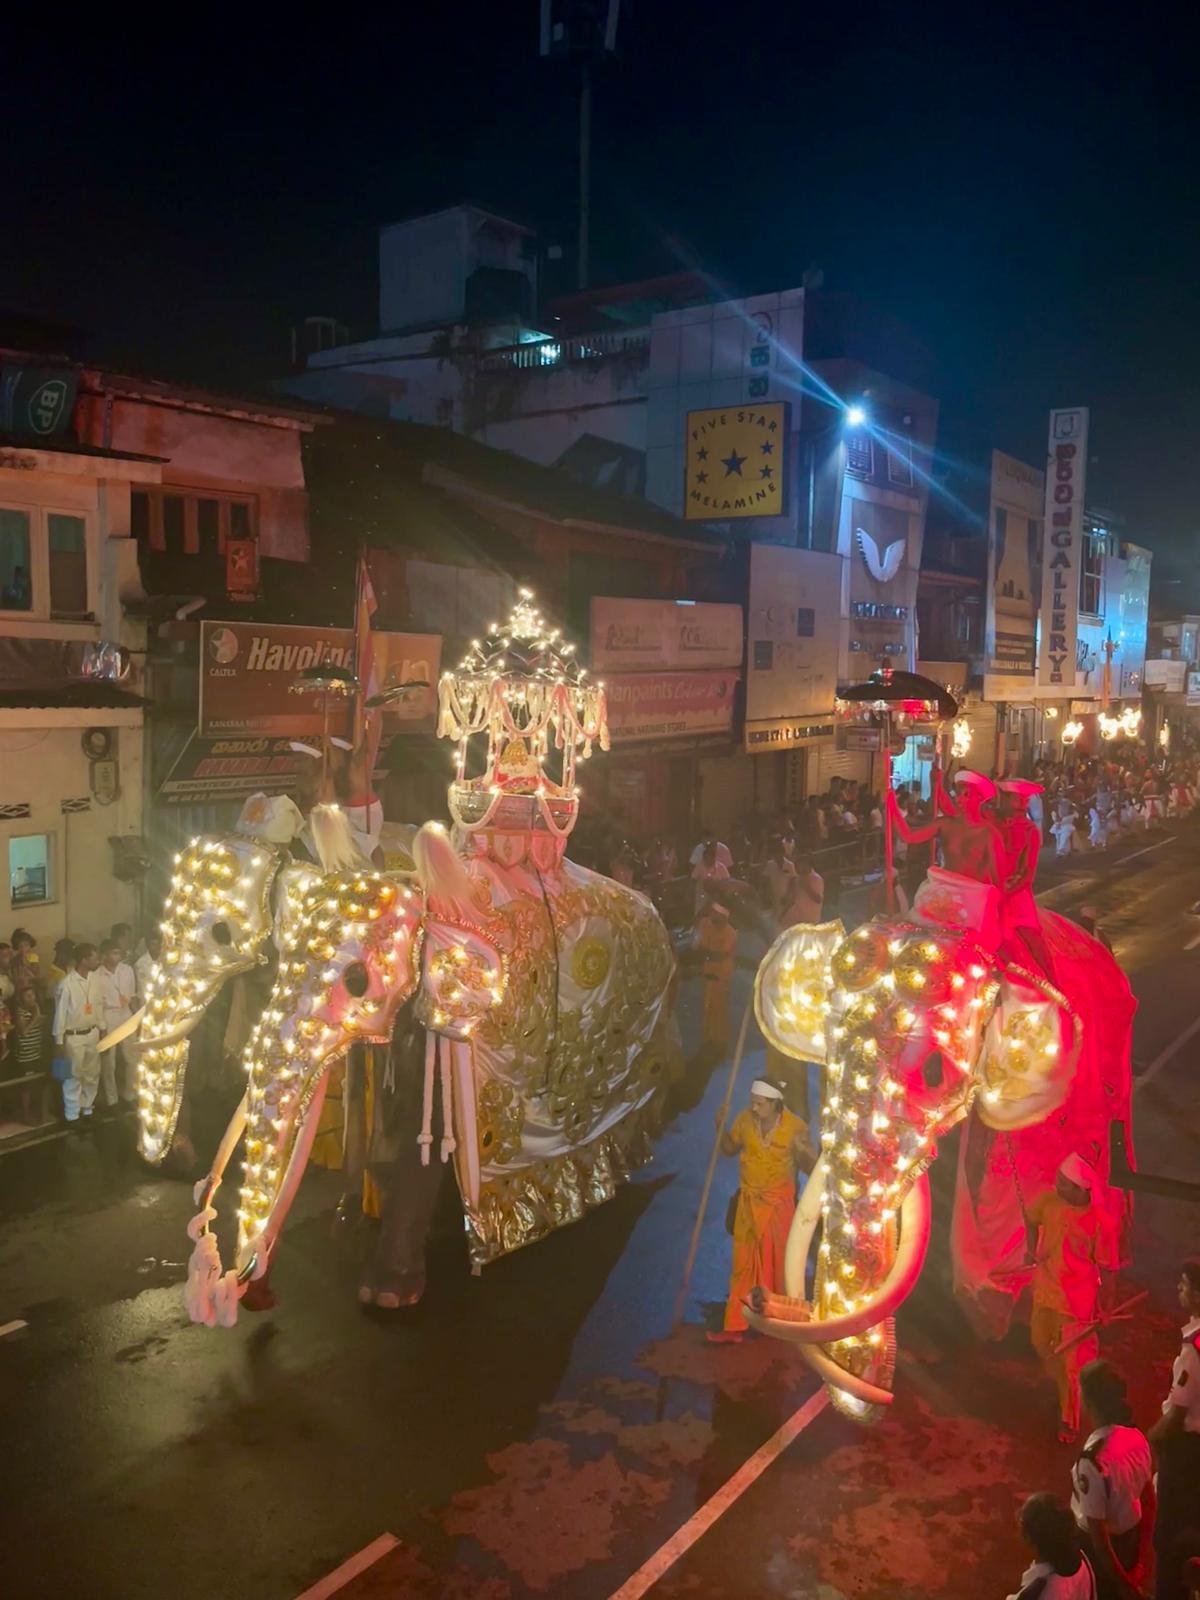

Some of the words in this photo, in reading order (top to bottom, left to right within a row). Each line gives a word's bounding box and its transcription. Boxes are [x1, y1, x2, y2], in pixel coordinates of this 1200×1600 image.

[37, 390, 59, 427] BP
[692, 414, 727, 440] FIVE
[737, 411, 777, 432] STAR
[690, 482, 776, 509] MELAMINE
[1048, 531, 1072, 673] GALLERY
